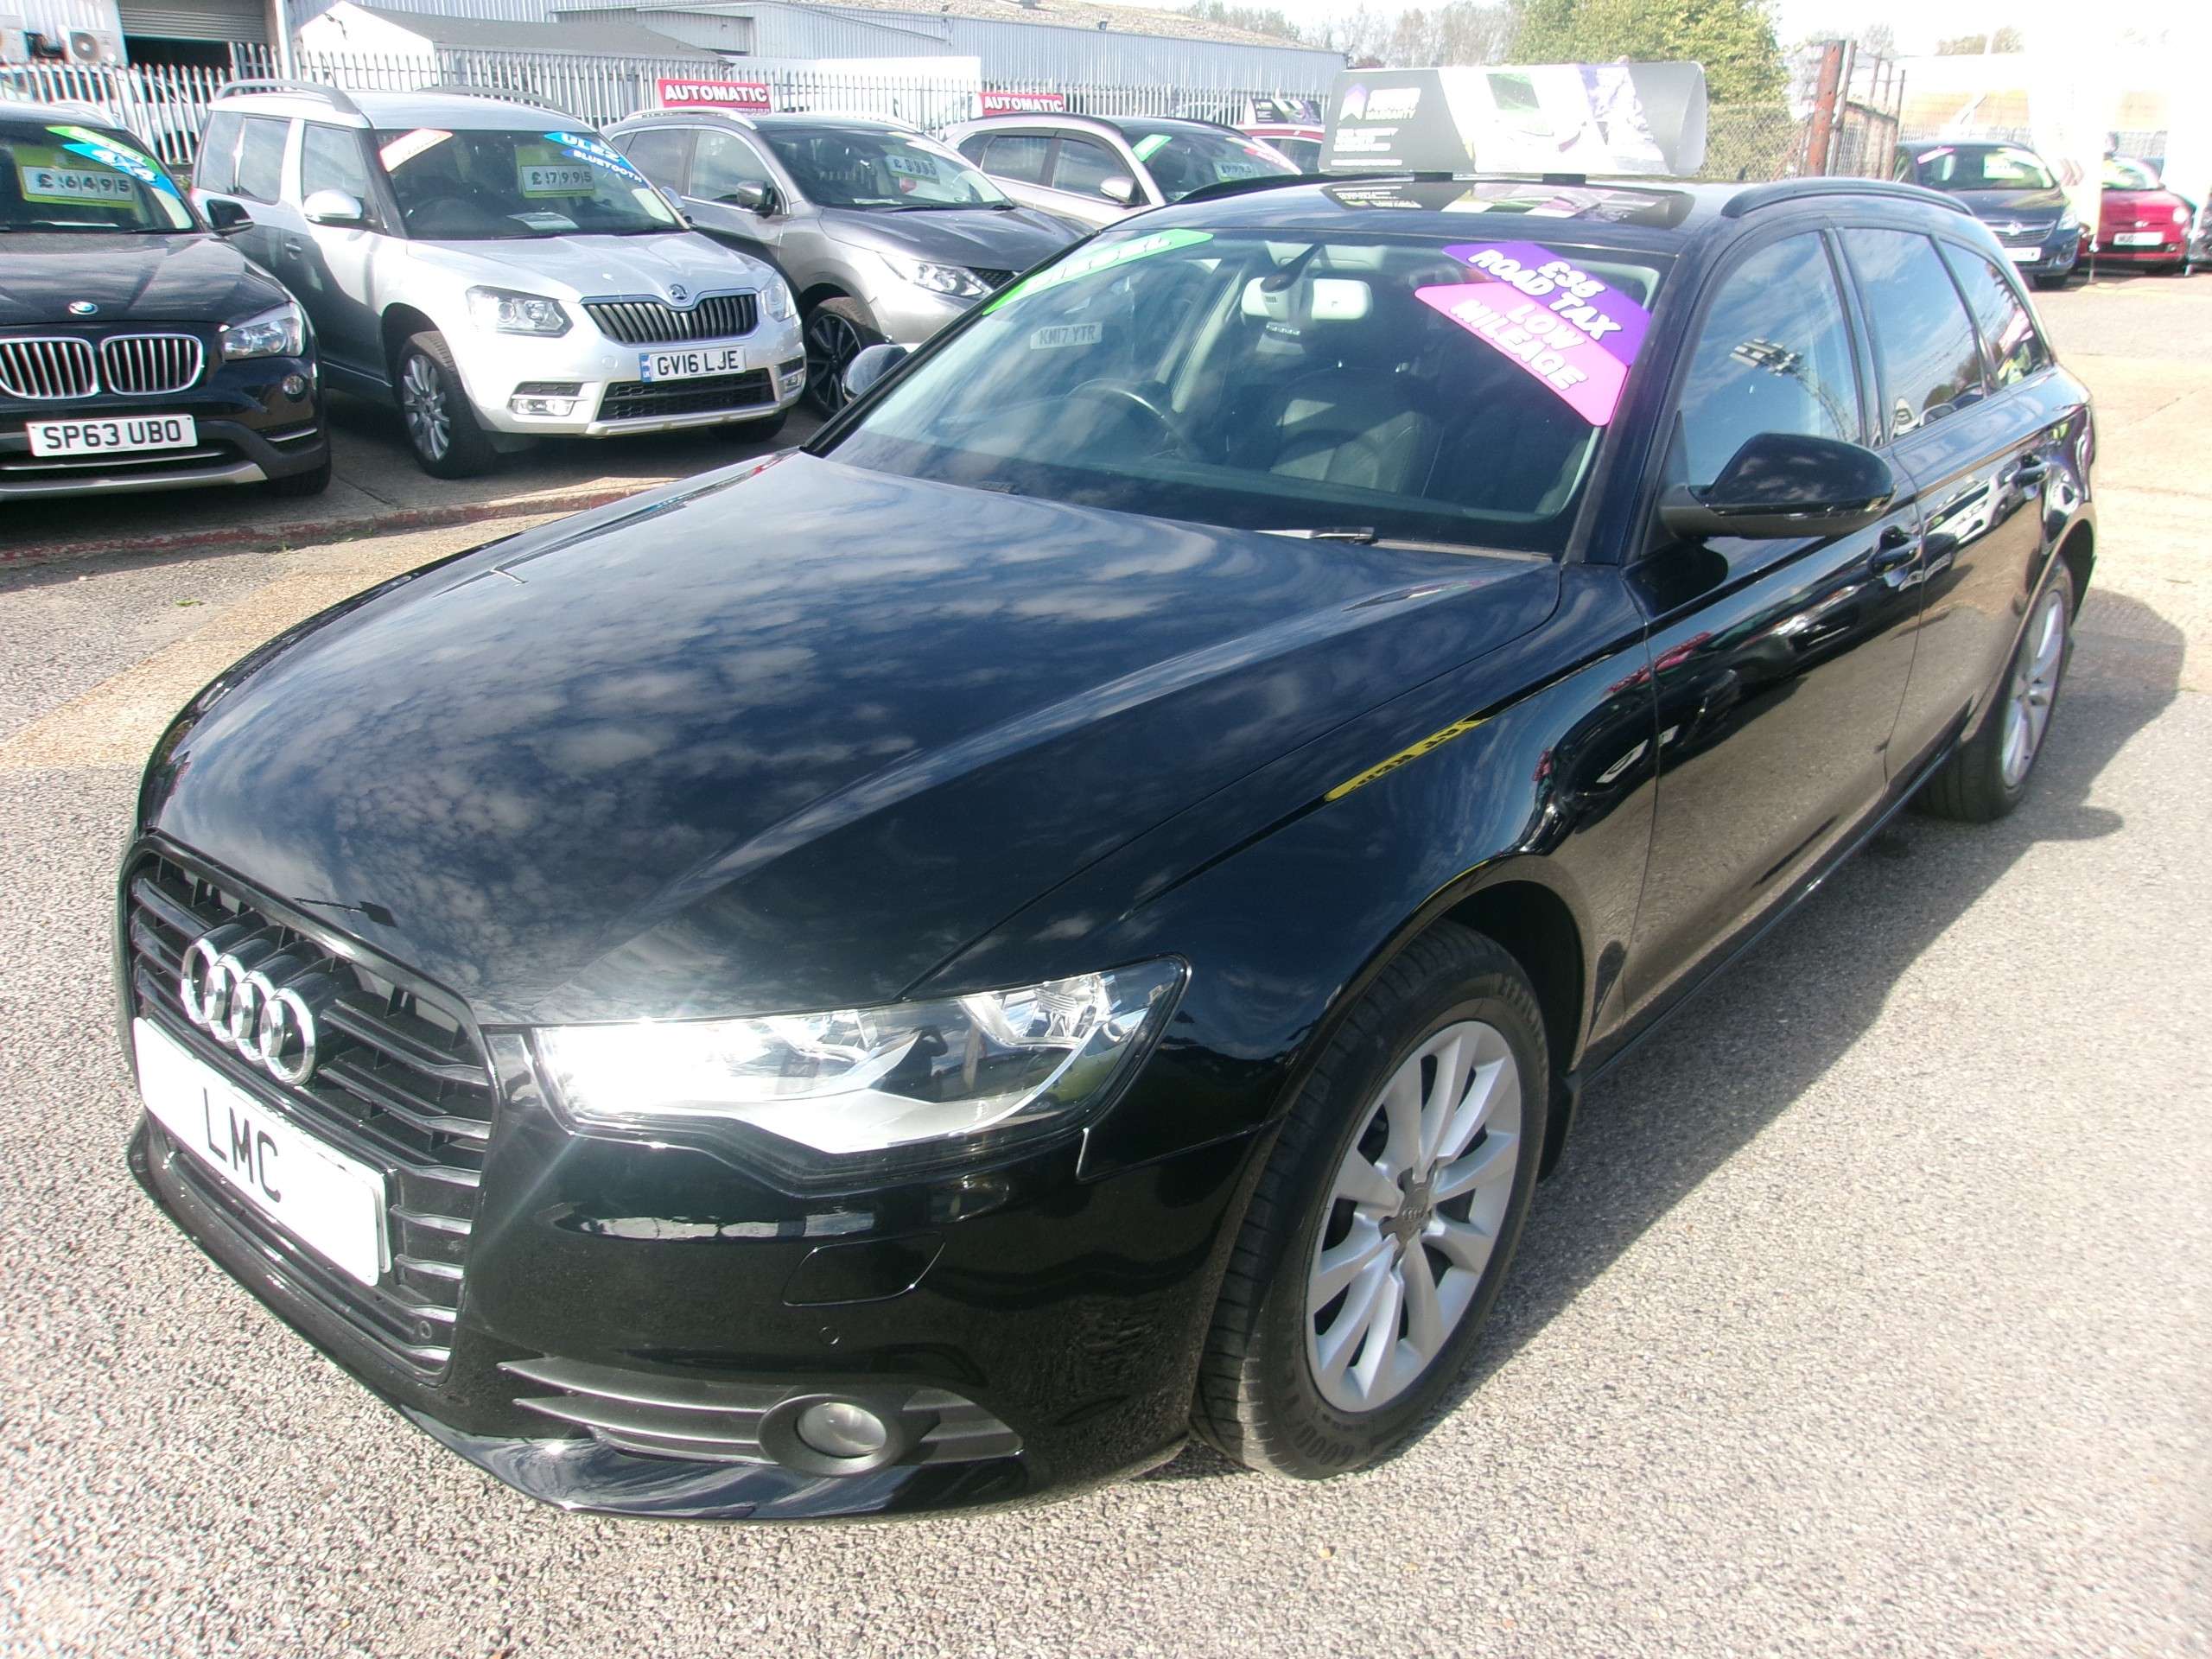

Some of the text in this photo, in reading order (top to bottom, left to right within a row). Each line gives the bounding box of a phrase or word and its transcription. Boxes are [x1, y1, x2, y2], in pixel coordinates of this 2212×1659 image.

[664, 84, 767, 103] AUTOMATIC
[984, 96, 1064, 112] AUTOMATIC
[562, 131, 621, 162] ULEZ
[573, 149, 642, 183] BLUETOOTH
[1467, 249, 1624, 340] ROAD TAX
[1536, 261, 1606, 298] £35
[1505, 303, 1586, 351] LOW
[1448, 299, 1589, 391] MILEAGE
[658, 351, 739, 376] GV16 LJE
[43, 420, 182, 449] SP63 UBO
[203, 1085, 282, 1204] LMC
